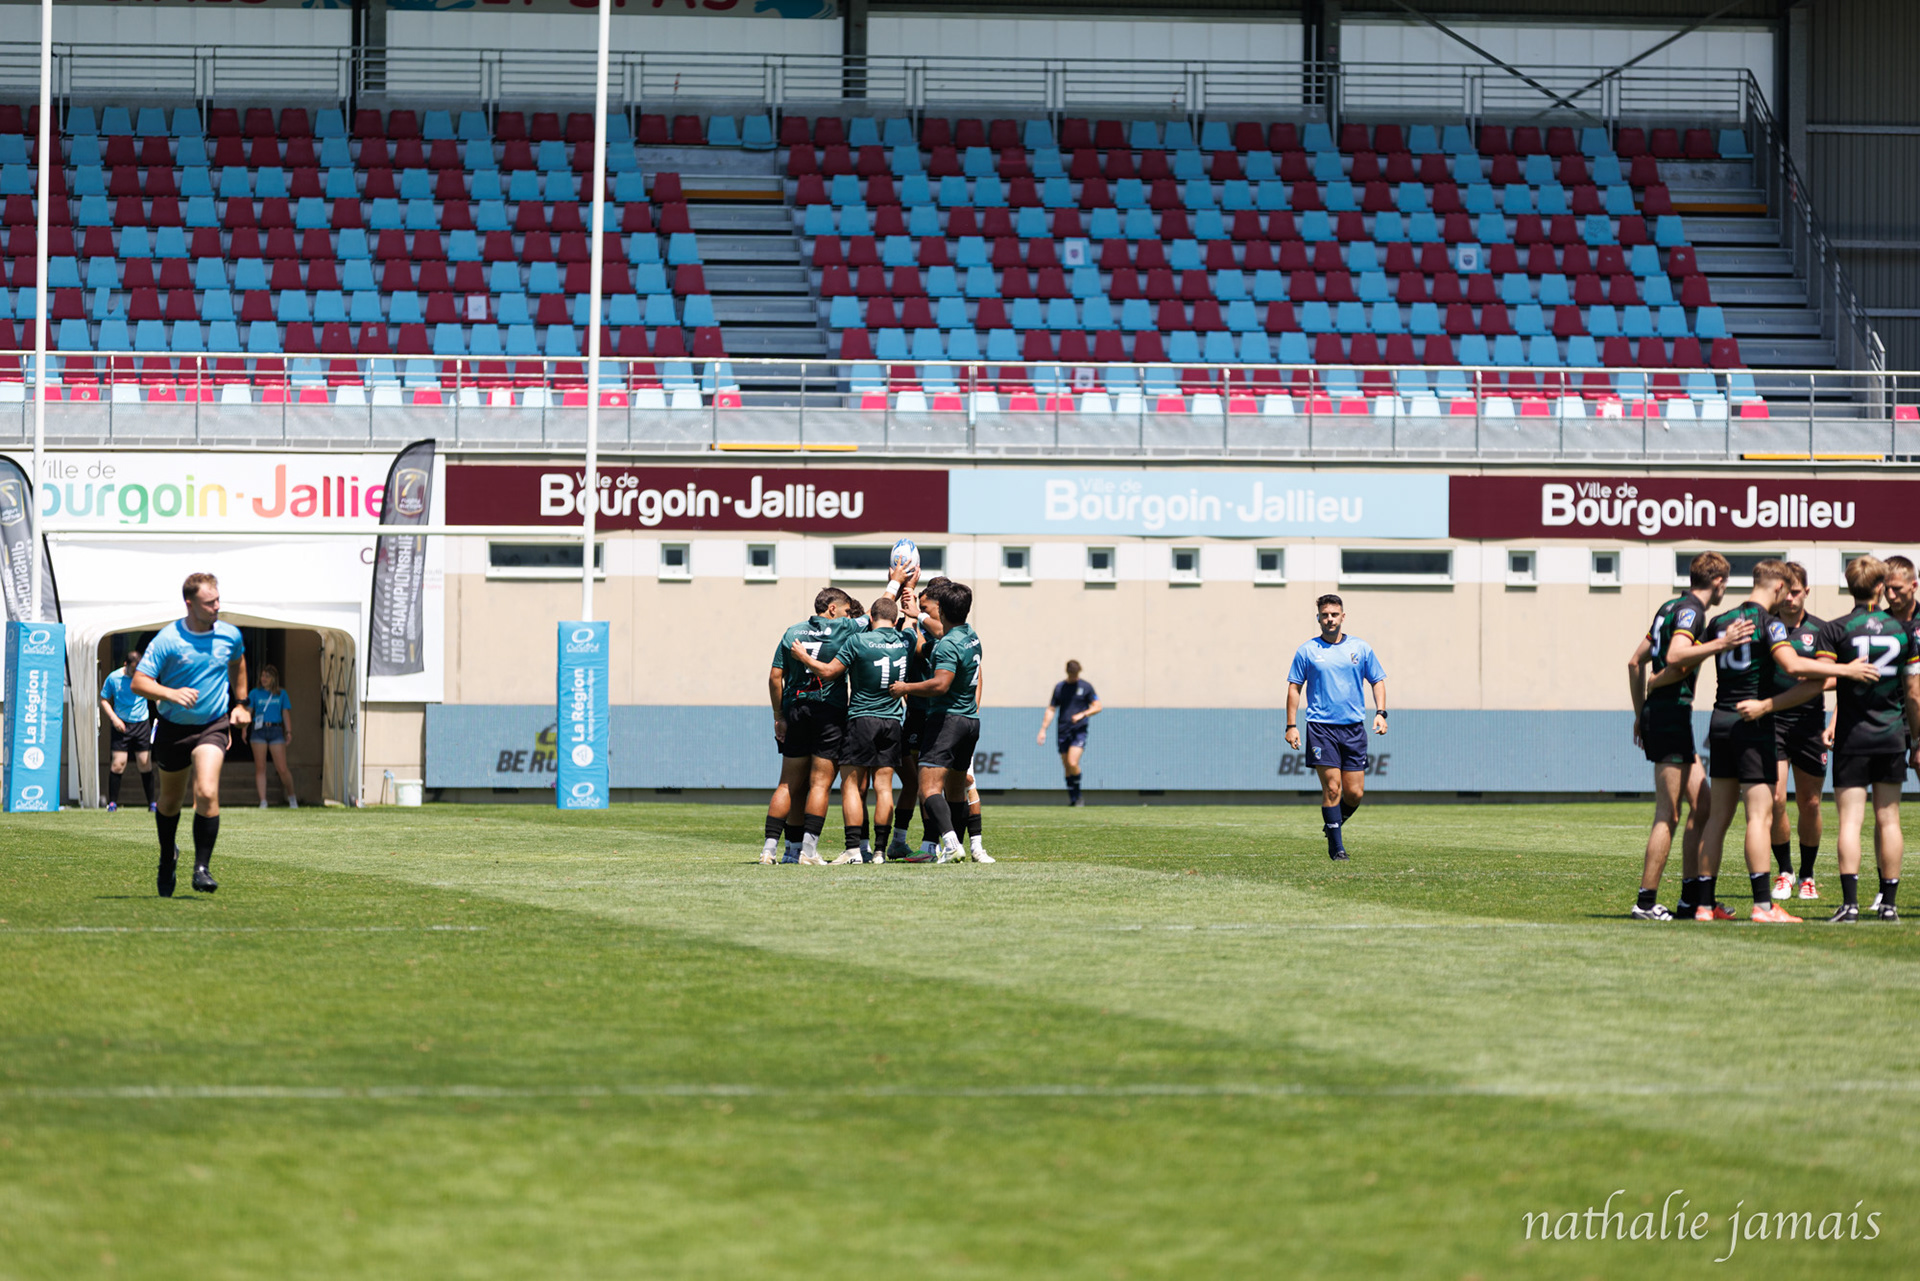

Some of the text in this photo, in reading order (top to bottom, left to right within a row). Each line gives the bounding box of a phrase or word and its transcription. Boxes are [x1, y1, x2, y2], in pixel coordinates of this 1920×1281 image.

[32, 460, 116, 479] ille de
[576, 472, 639, 488] Vle de
[1080, 478, 1142, 493] Ville de
[1576, 482, 1638, 498] Ville de
[391, 639, 406, 664] U18
[801, 641, 823, 674] 7
[1852, 635, 1901, 677] 12
[873, 655, 907, 689] 11
[24, 669, 41, 724] Région
[571, 669, 588, 722] Région
[24, 726, 37, 744] La
[571, 724, 585, 742] La
[496, 750, 528, 773] BE
